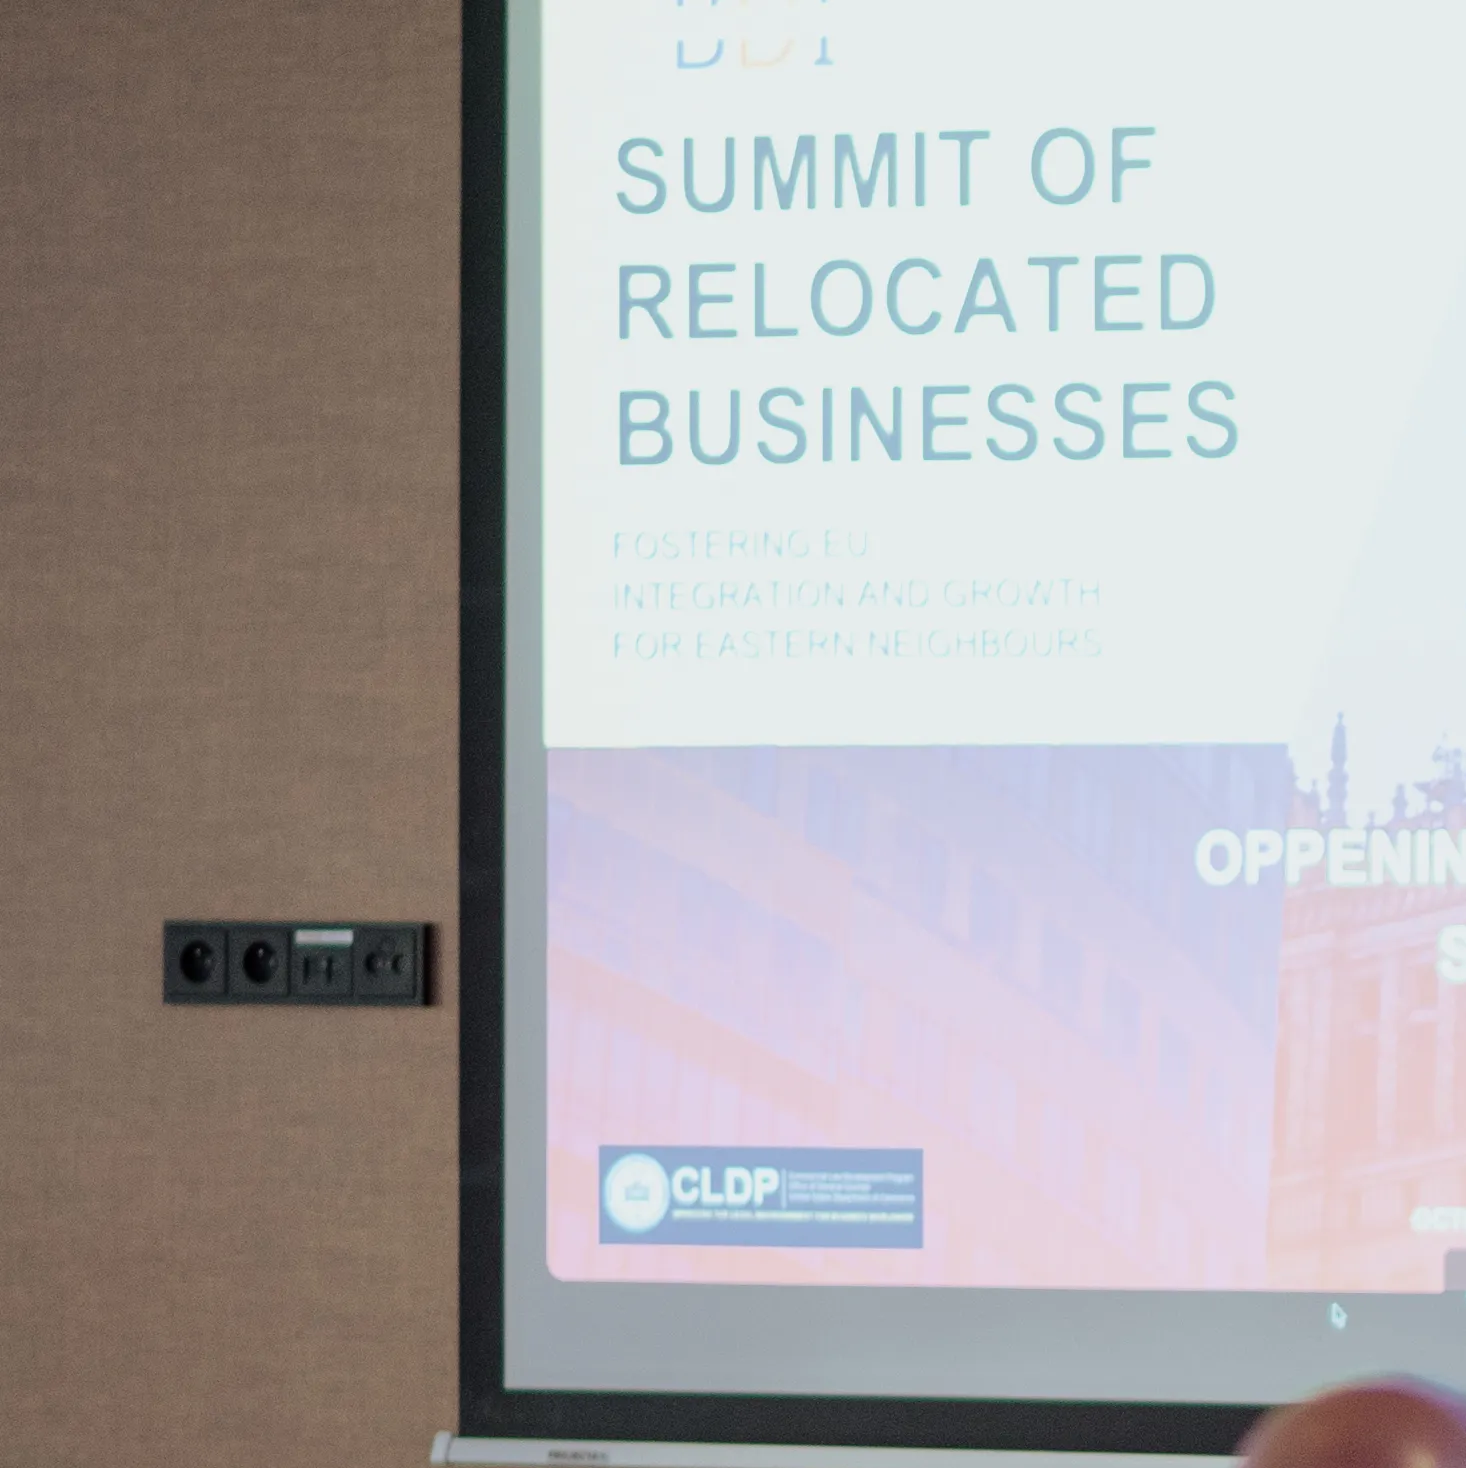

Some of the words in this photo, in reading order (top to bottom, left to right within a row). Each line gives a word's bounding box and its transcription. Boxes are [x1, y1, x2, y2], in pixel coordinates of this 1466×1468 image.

[616, 131, 990, 215] SUMMIT
[1031, 126, 1156, 206] OF
[617, 253, 1216, 340] RELOCATED
[617, 380, 1239, 466] BUSINESSES
[612, 528, 811, 561] FOSTERING
[822, 527, 870, 559] EU
[612, 580, 846, 611] INTEGRATION
[857, 578, 930, 609] AND
[942, 576, 1102, 608] GROWTH
[612, 630, 684, 661] FOR
[695, 628, 856, 660] EASTERN
[868, 626, 1104, 659] NEIGHBOURS
[671, 1165, 780, 1207] CLDP
